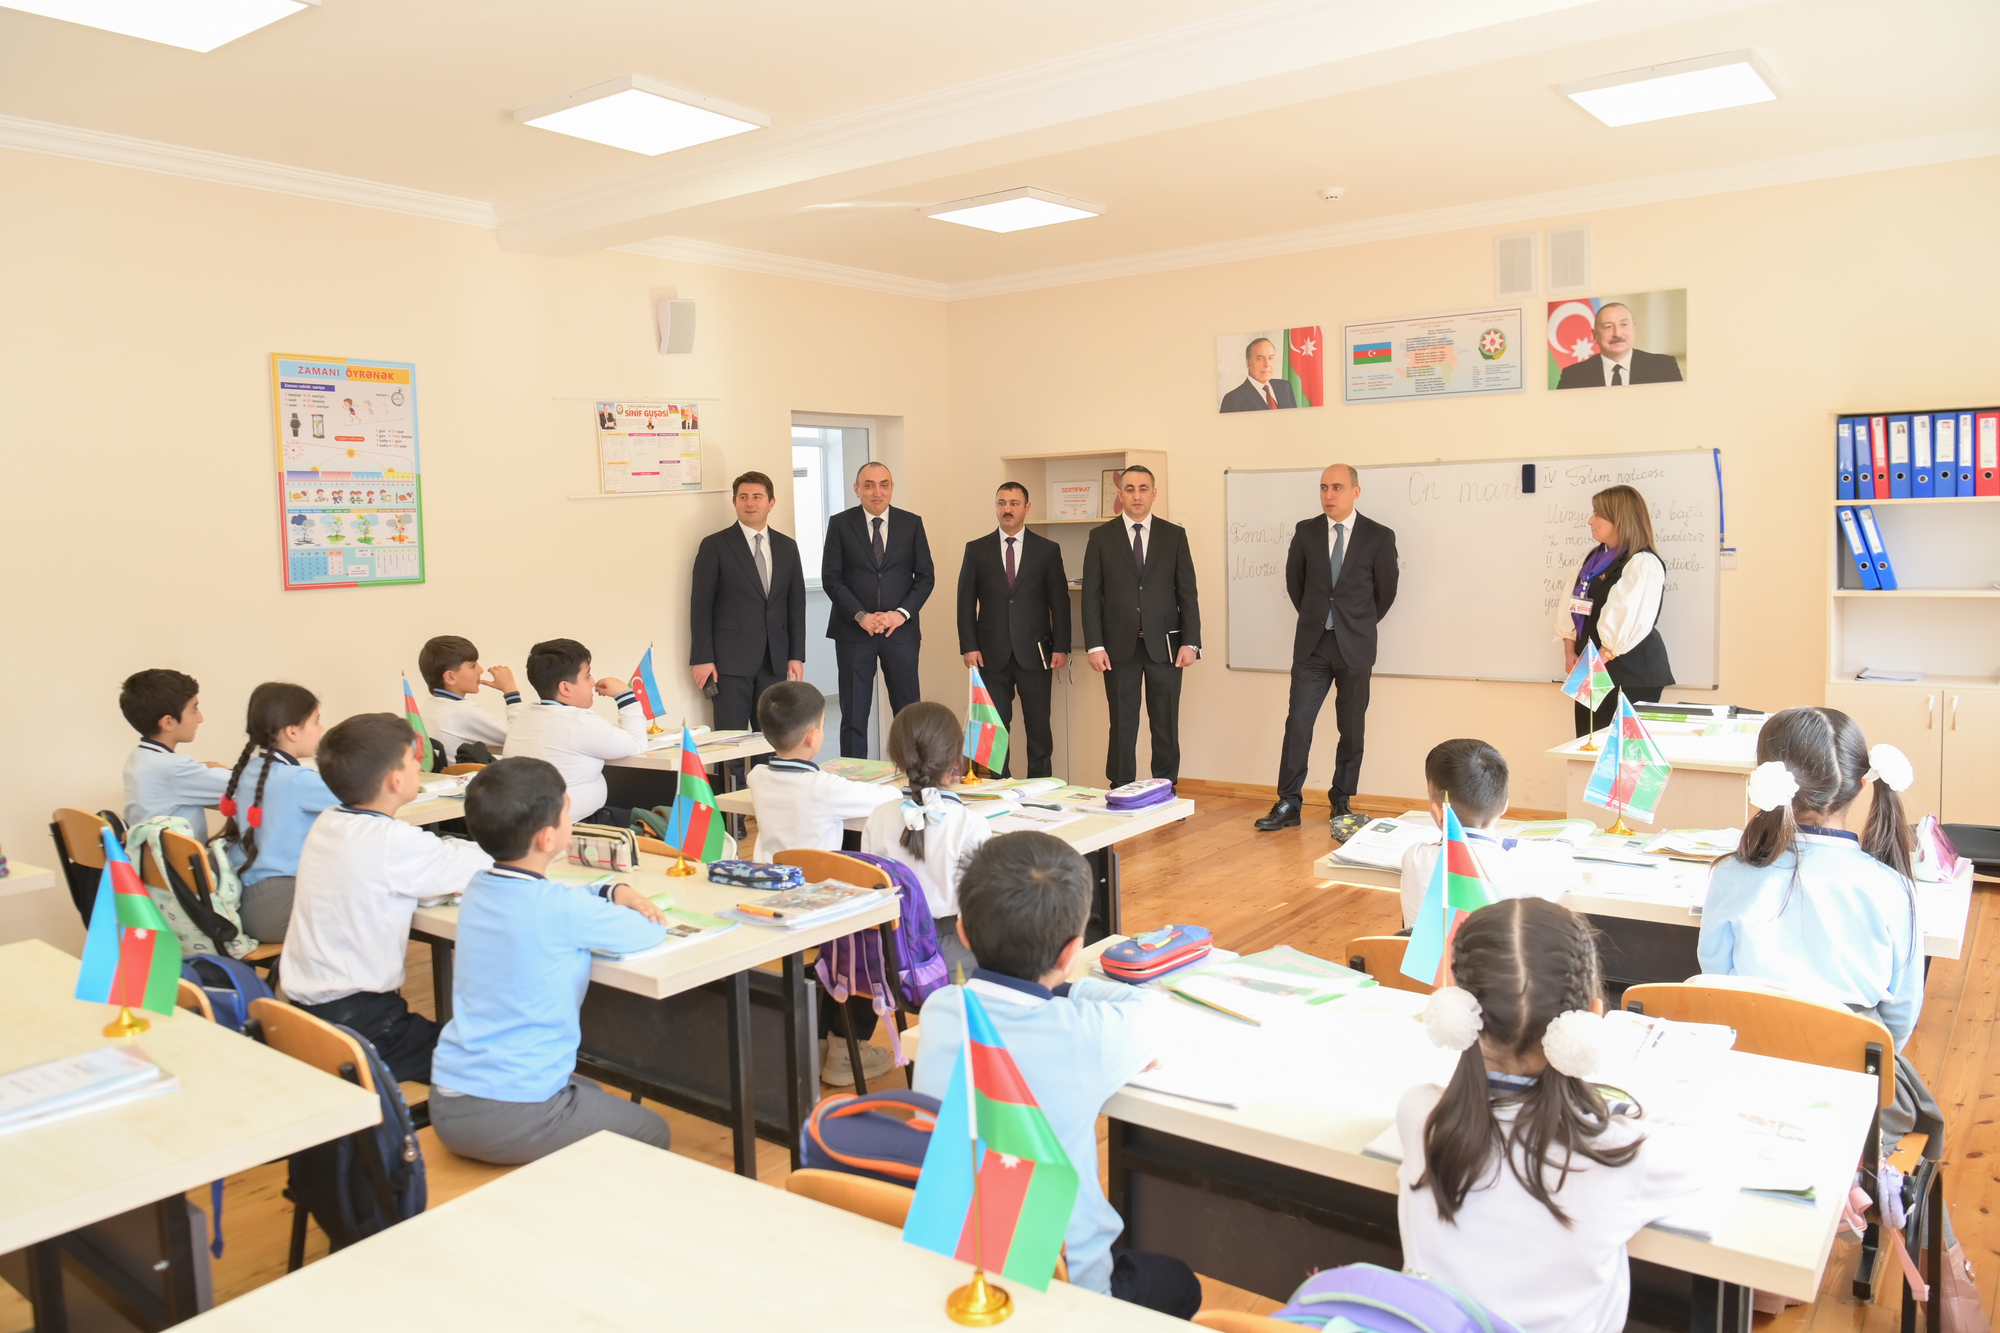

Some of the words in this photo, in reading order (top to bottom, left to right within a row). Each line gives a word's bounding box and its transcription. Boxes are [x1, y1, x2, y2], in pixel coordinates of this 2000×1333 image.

[298, 366, 340, 376] ZAMANI
[346, 368, 394, 380] ÖYRƏNƏK
[625, 408, 642, 417] SİNİF
[644, 408, 669, 419] GUŞƏSİ
[1409, 471, 1442, 505] On
[1543, 502, 1591, 528] Müəyy
[1274, 523, 1294, 544] Az
[1565, 532, 1596, 546] möv
[1655, 528, 1706, 543] slandırır
